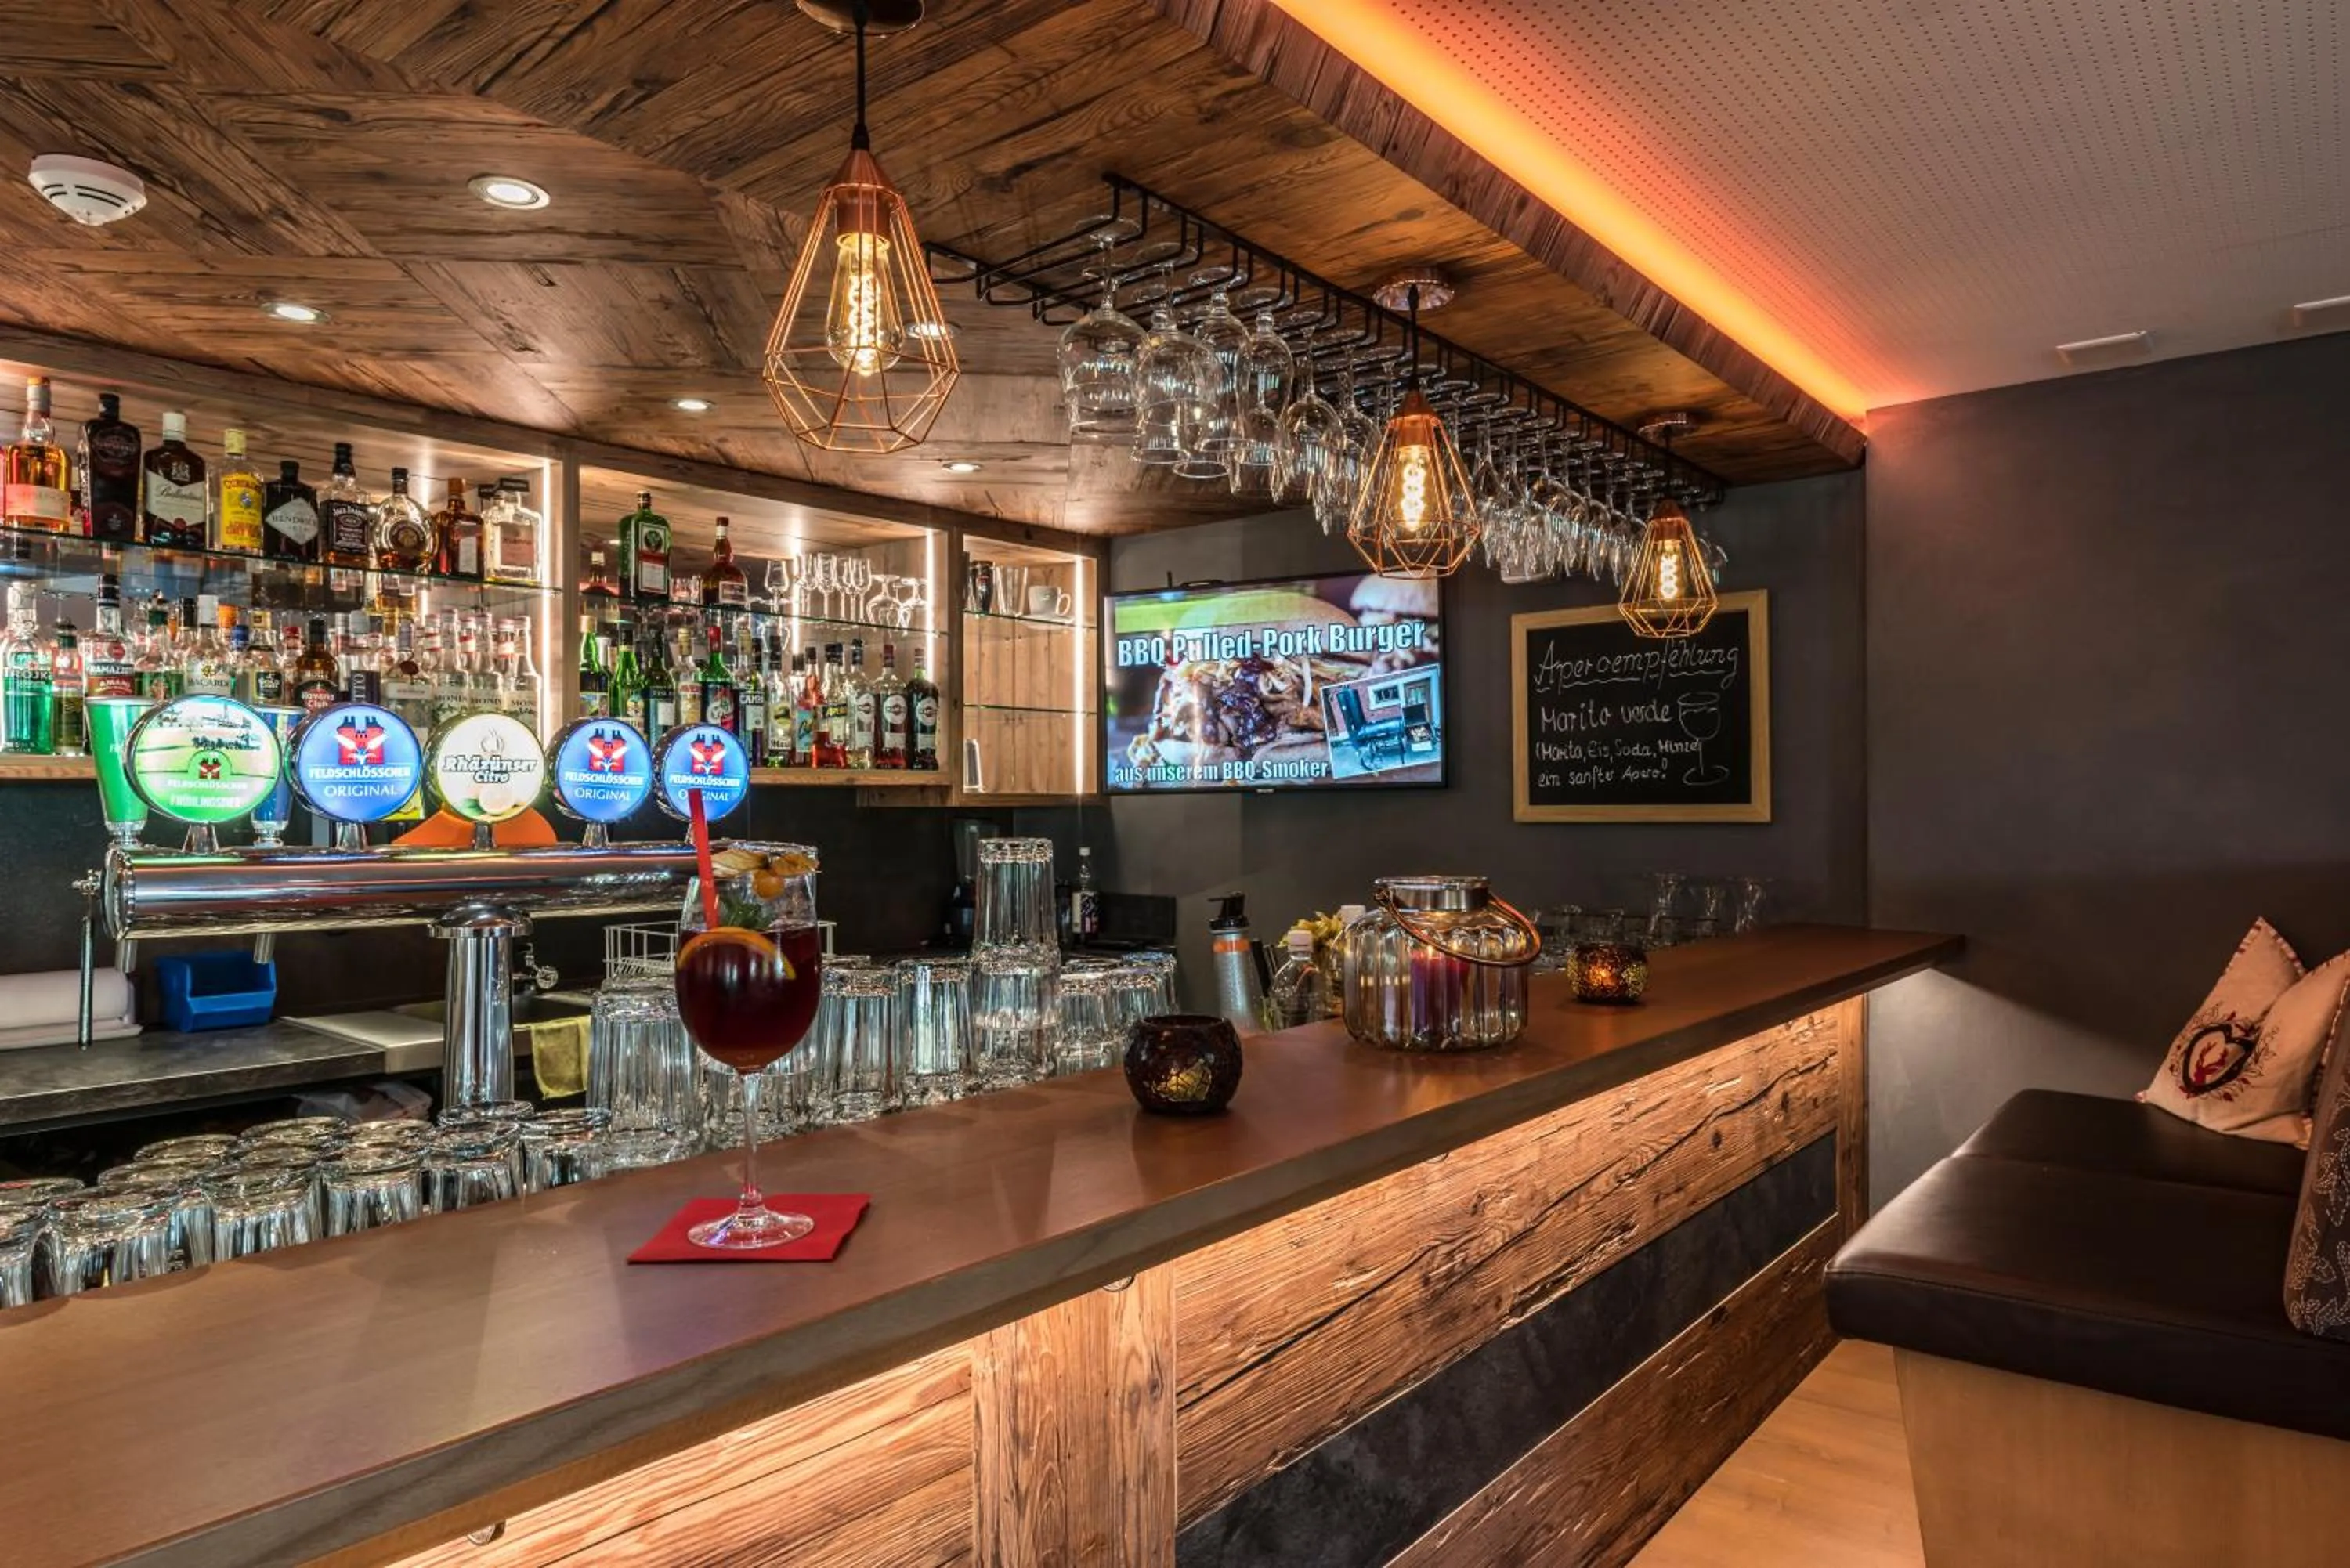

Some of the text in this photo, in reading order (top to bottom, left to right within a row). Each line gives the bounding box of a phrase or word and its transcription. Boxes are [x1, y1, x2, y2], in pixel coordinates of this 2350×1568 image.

[1117, 620, 1426, 668] BBQ Pulled-Pork Burger
[473, 770, 510, 783] Citro
[1115, 759, 1329, 783] aus unserem BBQ-Smoker
[1538, 773, 1561, 788] ein
[1568, 764, 1615, 790] sanfter
[324, 785, 399, 797] ORIGINAL
[574, 788, 631, 800] ORIGINAL
[678, 789, 729, 800] OGINAL
